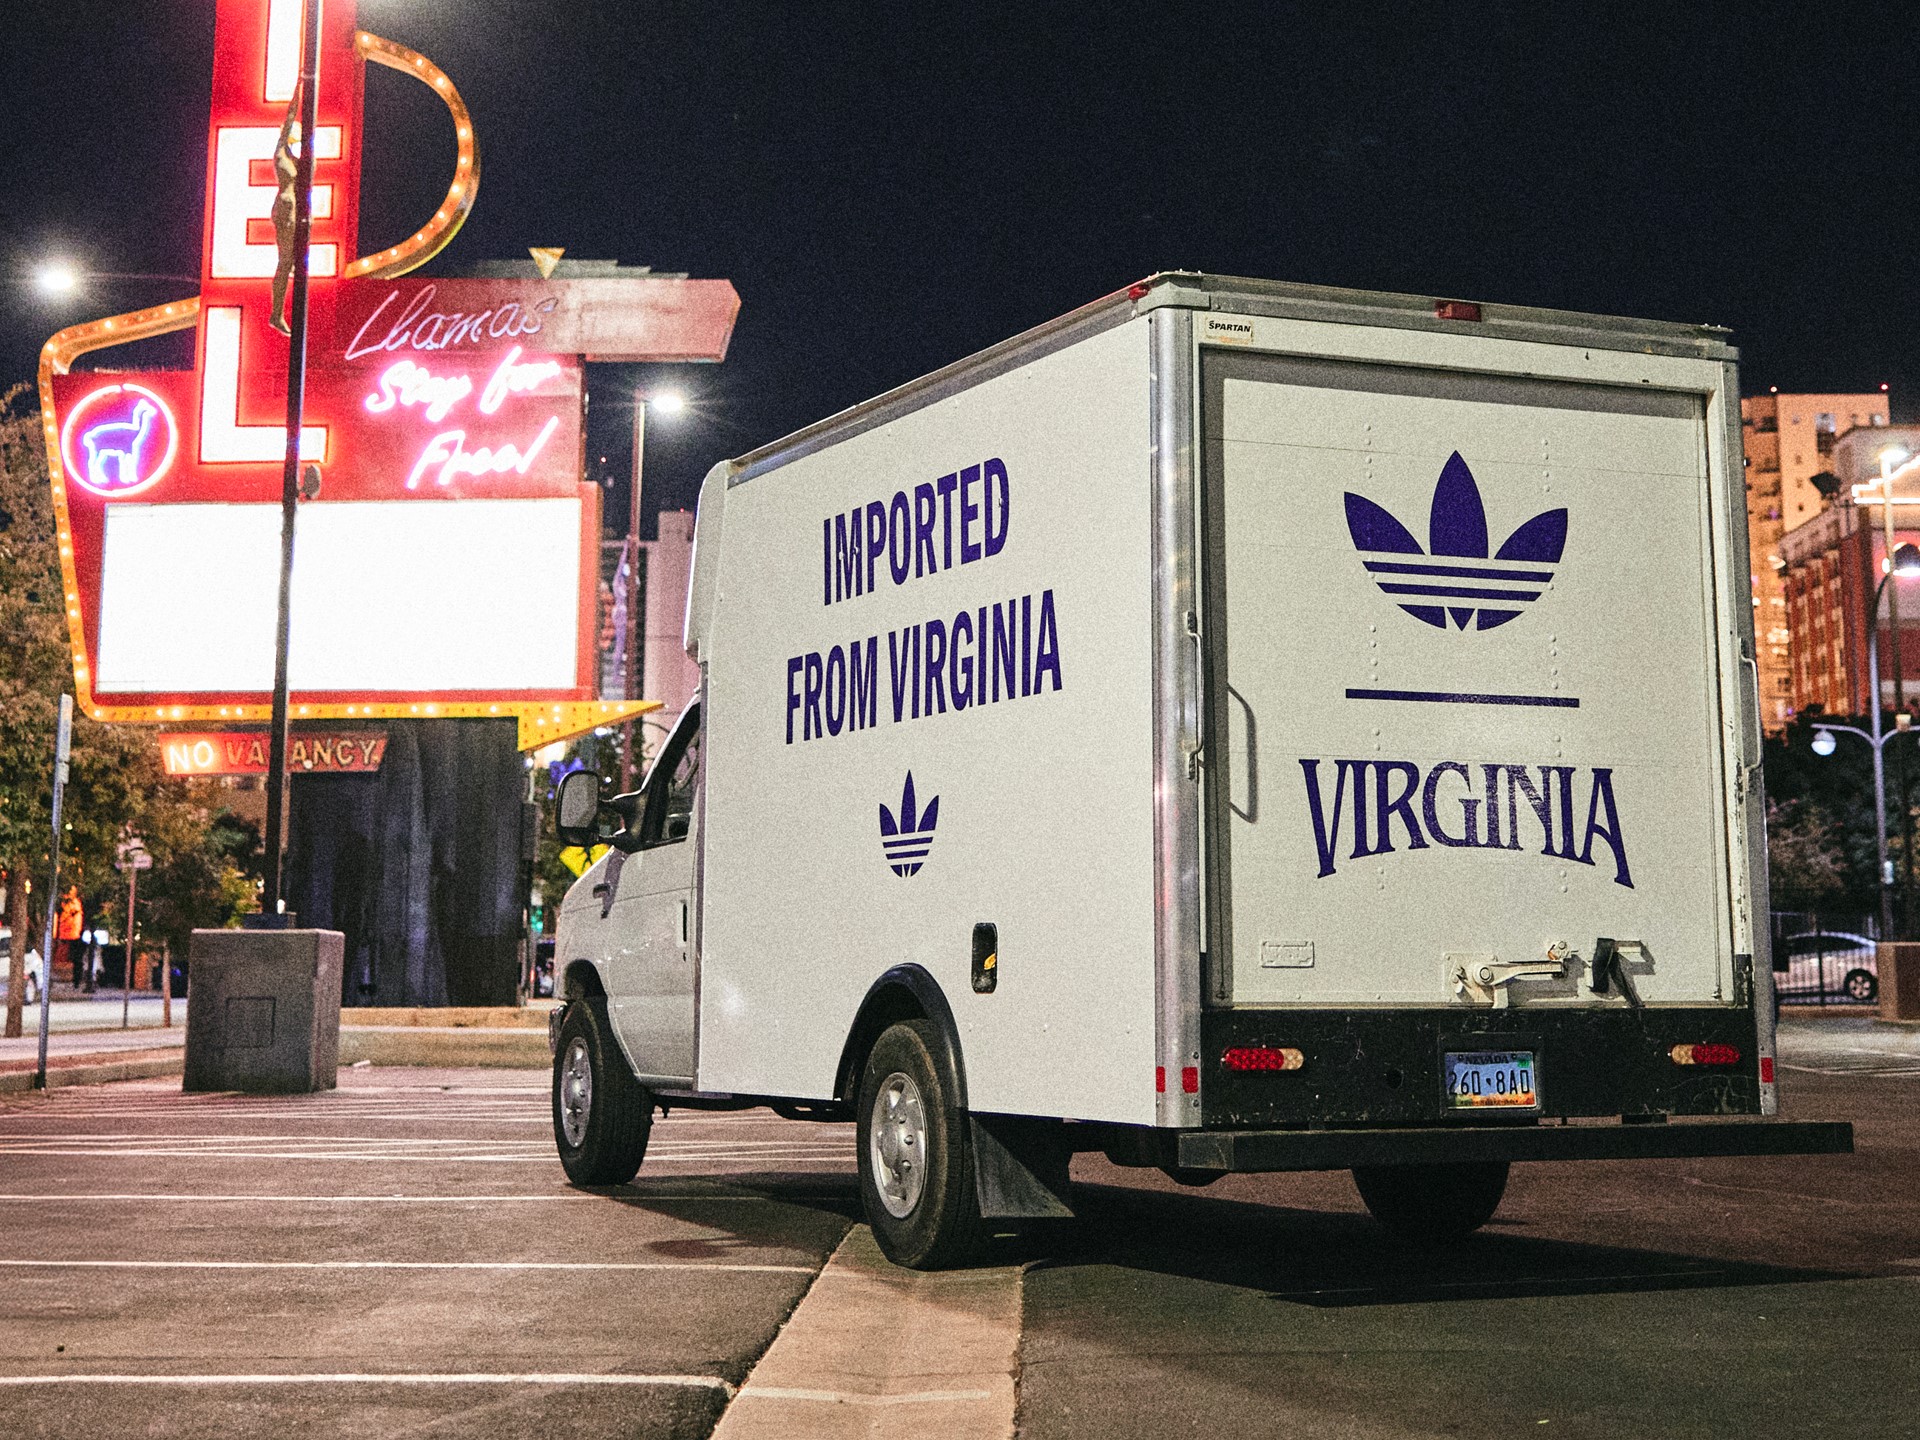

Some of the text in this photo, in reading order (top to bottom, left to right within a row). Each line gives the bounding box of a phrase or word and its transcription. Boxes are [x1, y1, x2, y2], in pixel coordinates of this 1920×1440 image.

[345, 284, 558, 360] Llamas
[1209, 320, 1251, 332] SPARTAN
[365, 360, 472, 422] Stay
[823, 457, 1010, 606] IMPORTED
[786, 589, 1063, 745] FROM VIRGINIA
[168, 739, 377, 772] NO VAANCY
[1298, 759, 1635, 889] VIRGINIA
[1465, 1055, 1509, 1065] NEVADA
